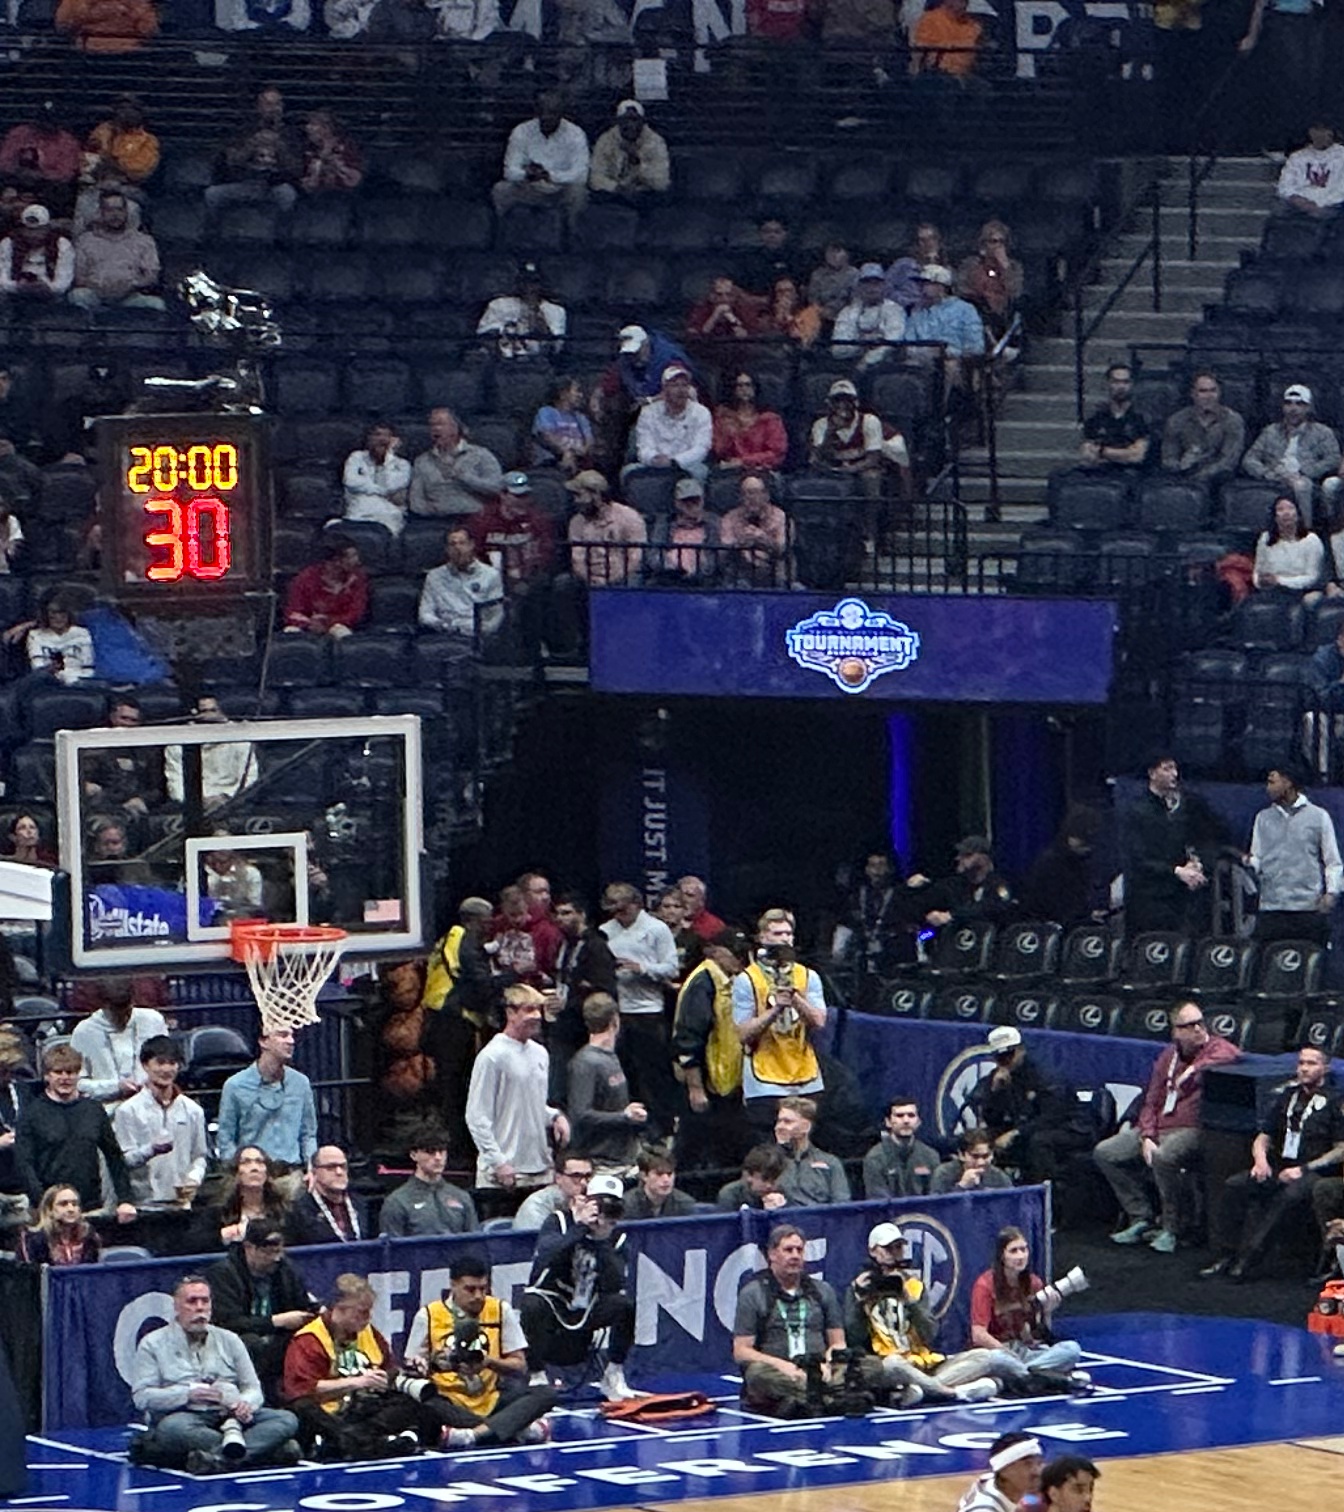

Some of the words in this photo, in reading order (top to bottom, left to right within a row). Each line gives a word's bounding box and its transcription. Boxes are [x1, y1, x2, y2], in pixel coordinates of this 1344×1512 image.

[128, 444, 238, 493] 20:00
[145, 498, 231, 583] 30
[791, 633, 913, 655] TOURNAMENT
[643, 796, 668, 862] JUST
